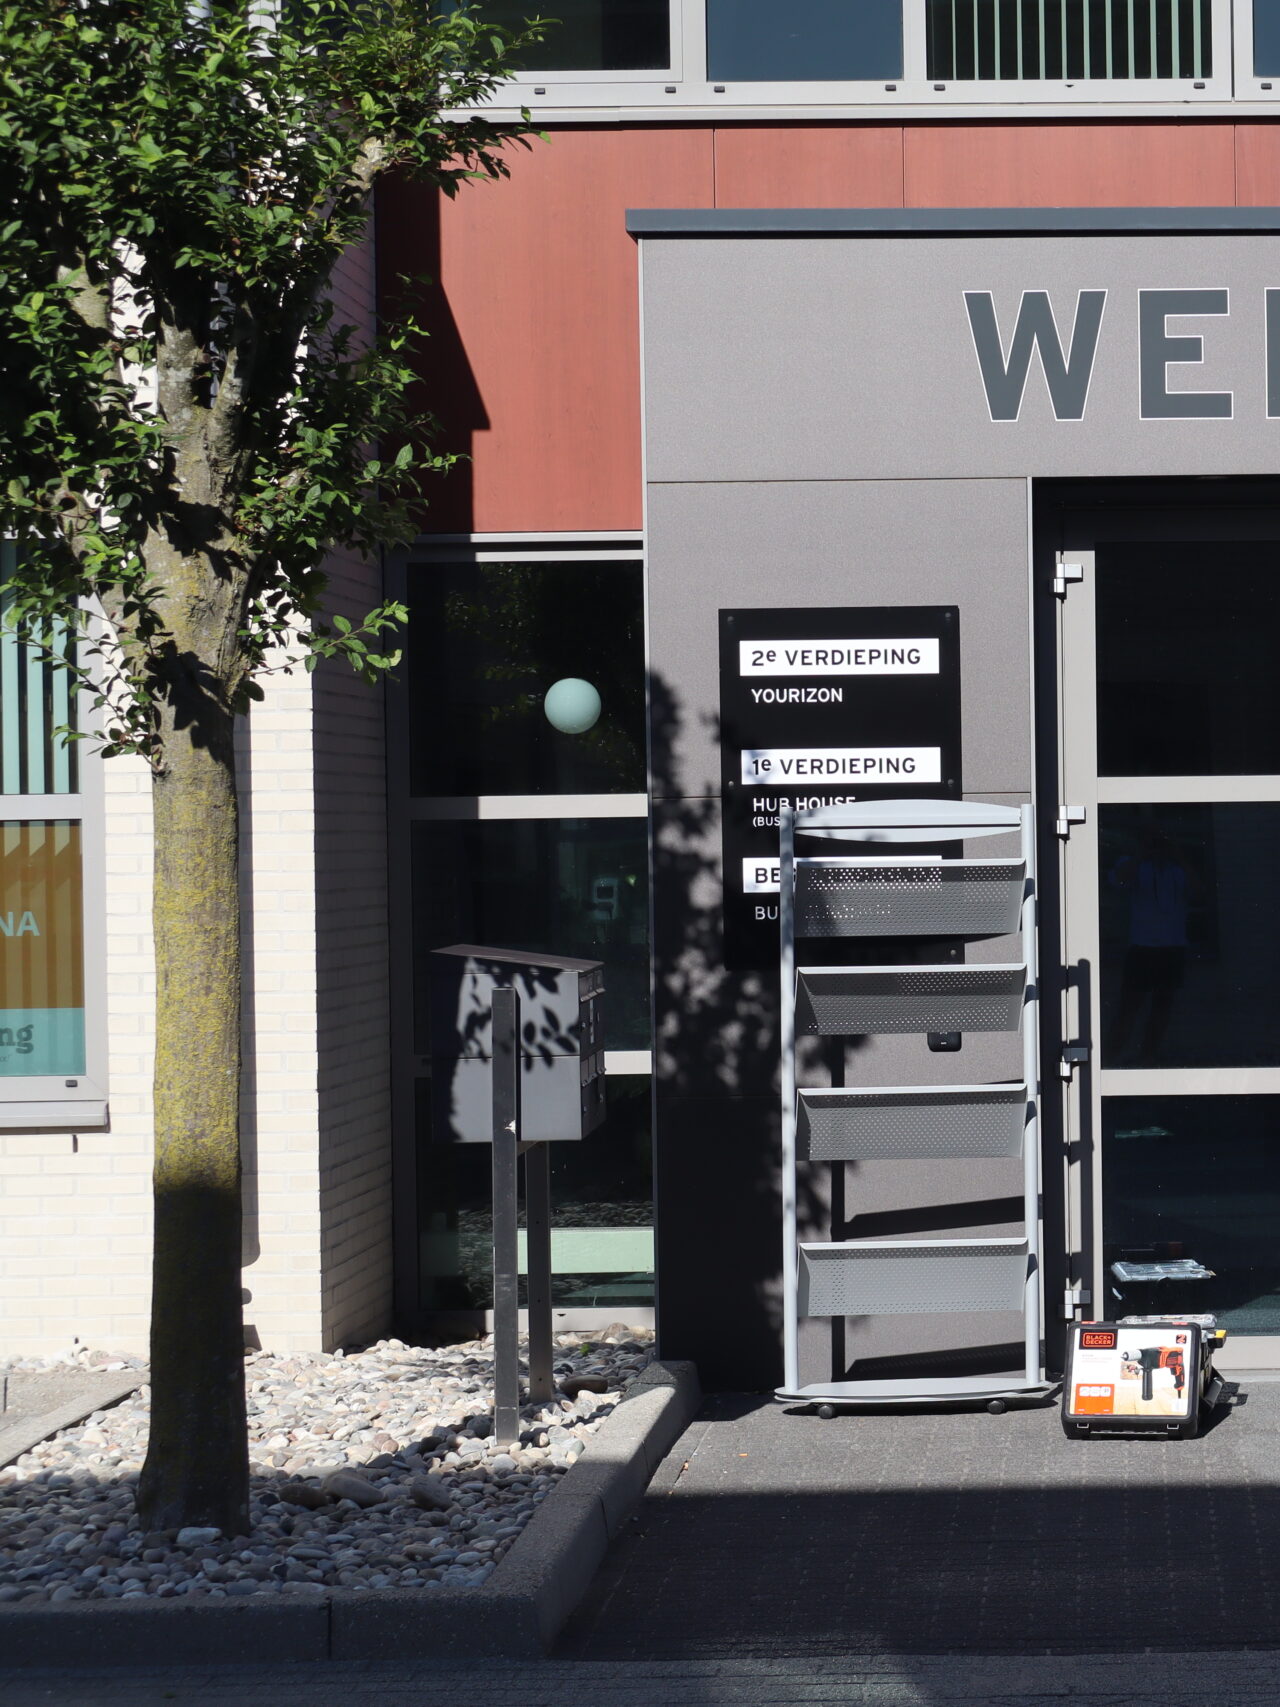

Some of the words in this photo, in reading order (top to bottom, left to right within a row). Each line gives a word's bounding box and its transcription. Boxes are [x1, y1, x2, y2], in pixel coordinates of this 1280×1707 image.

[751, 648, 777, 667] 2e
[785, 648, 922, 666] VERDIEPING
[751, 688, 844, 703] YOURIZON
[752, 758, 772, 776] 1e
[780, 757, 916, 775] VERDIEPING
[753, 797, 789, 812] HUB
